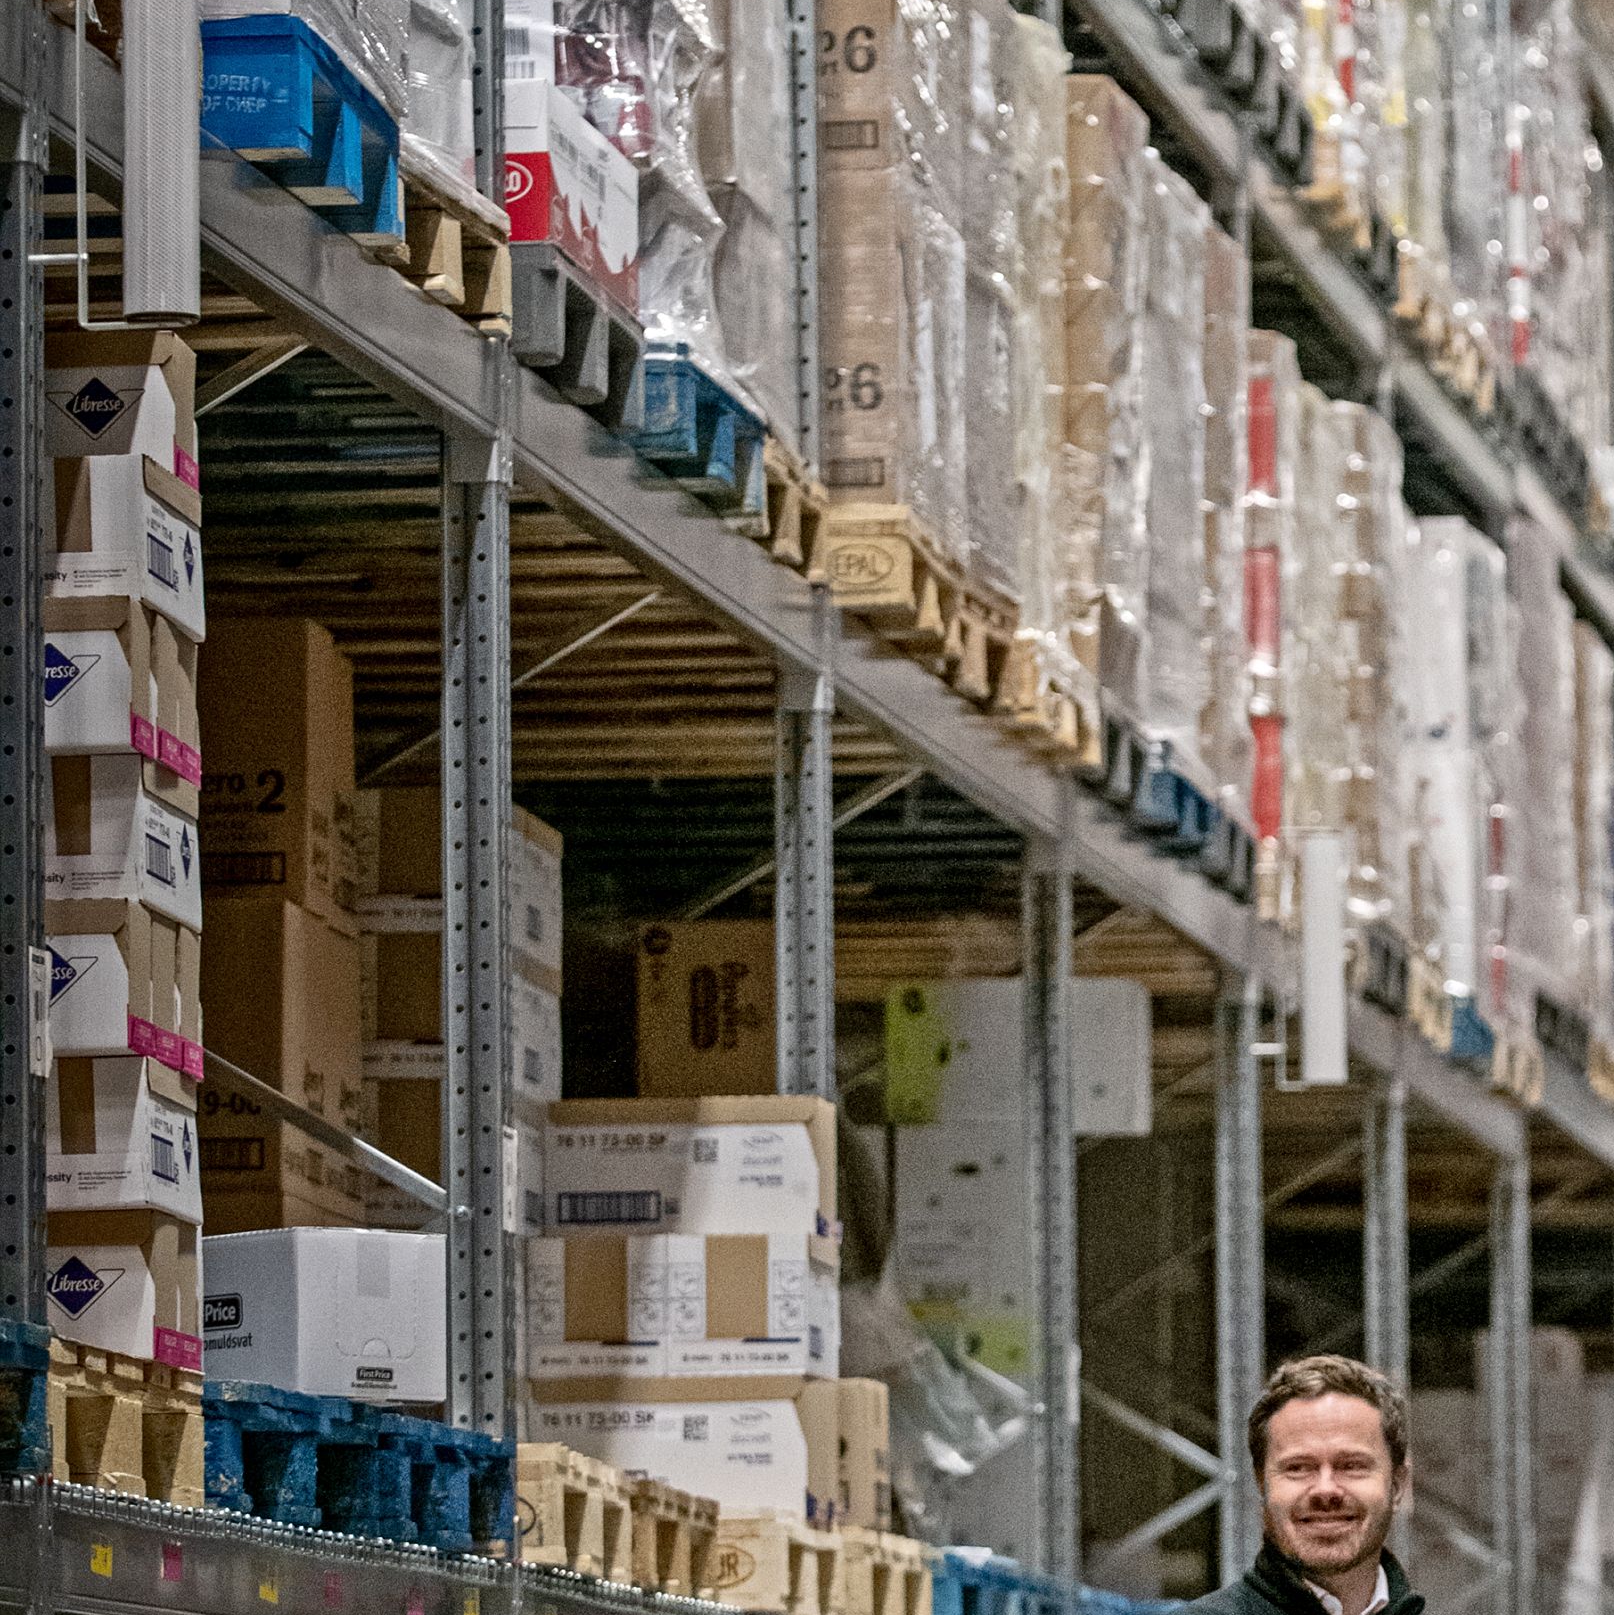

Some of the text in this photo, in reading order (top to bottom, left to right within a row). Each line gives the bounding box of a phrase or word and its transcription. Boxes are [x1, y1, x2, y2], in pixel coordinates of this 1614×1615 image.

[843, 25, 877, 74] 6
[852, 362, 884, 410] 6
[72, 395, 121, 414] Libresse
[45, 665, 79, 679] resse
[257, 768, 286, 813] 2
[51, 1273, 101, 1294] Libresse
[204, 1302, 237, 1322] Price
